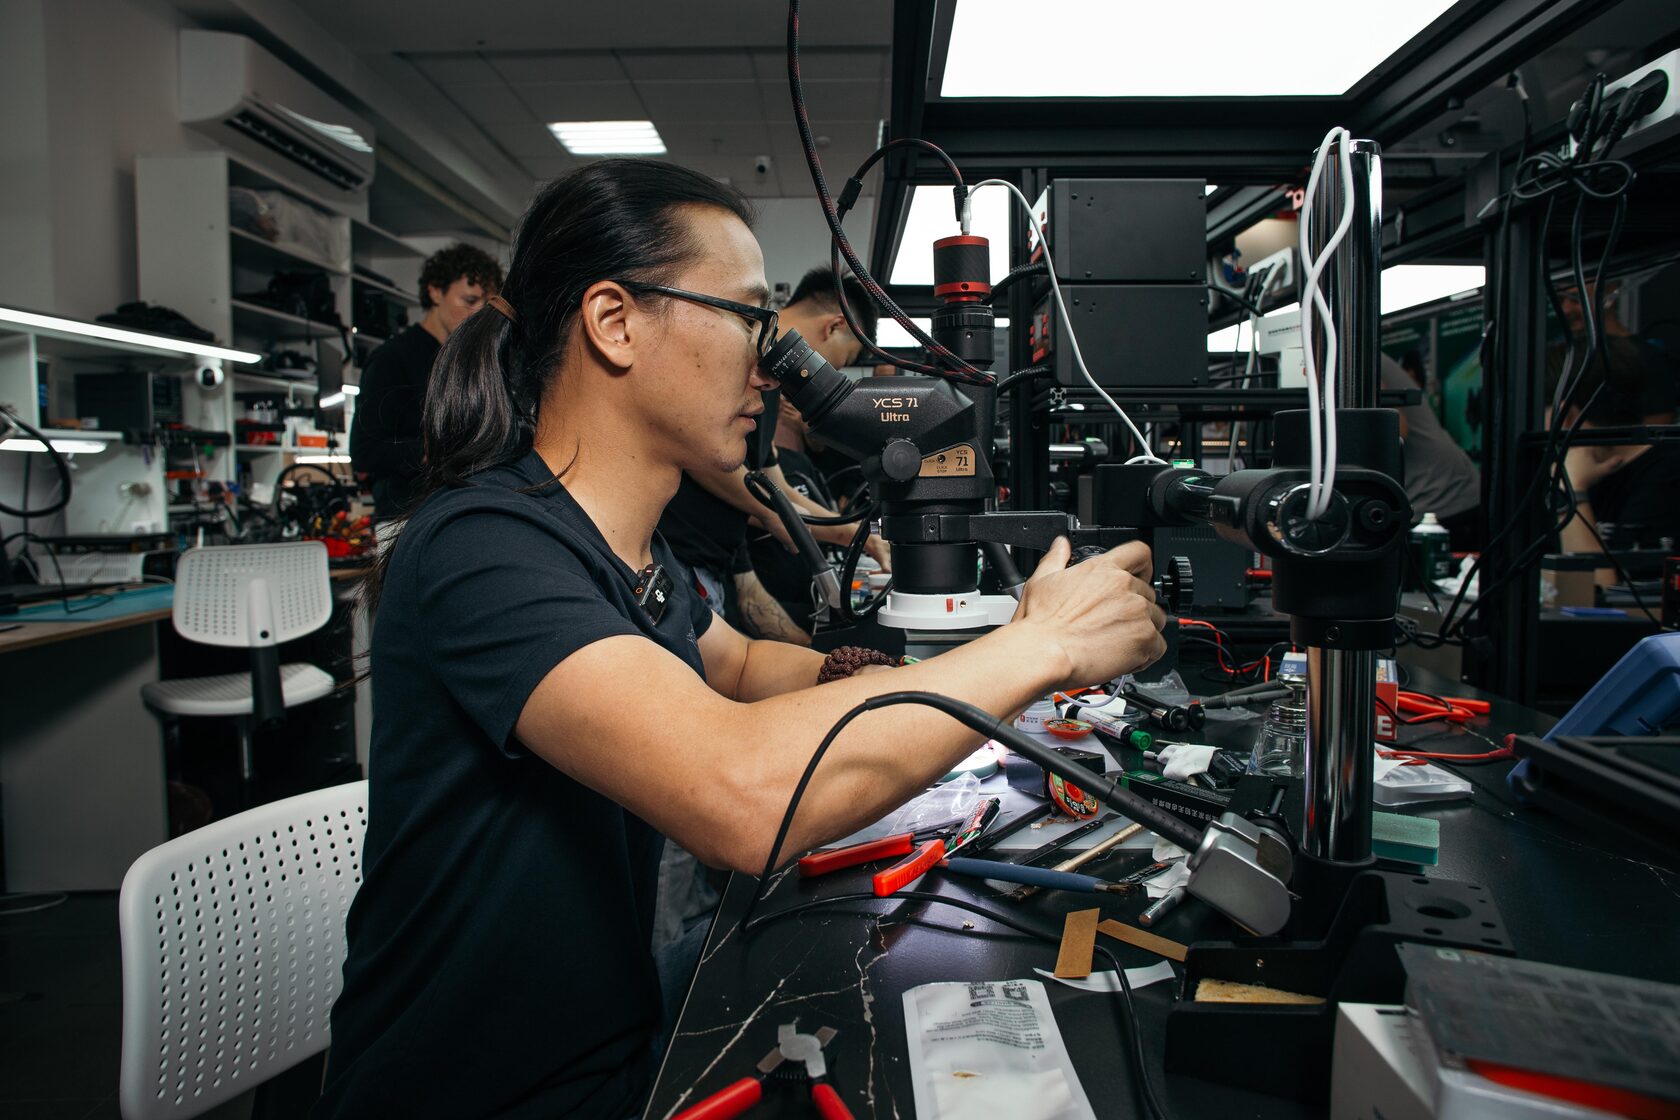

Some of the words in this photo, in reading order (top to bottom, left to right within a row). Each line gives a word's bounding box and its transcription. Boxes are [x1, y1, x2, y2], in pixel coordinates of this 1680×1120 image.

[872, 397, 903, 408] YCS
[906, 397, 918, 408] 71
[880, 412, 910, 422] Ultra
[956, 456, 968, 467] 71
